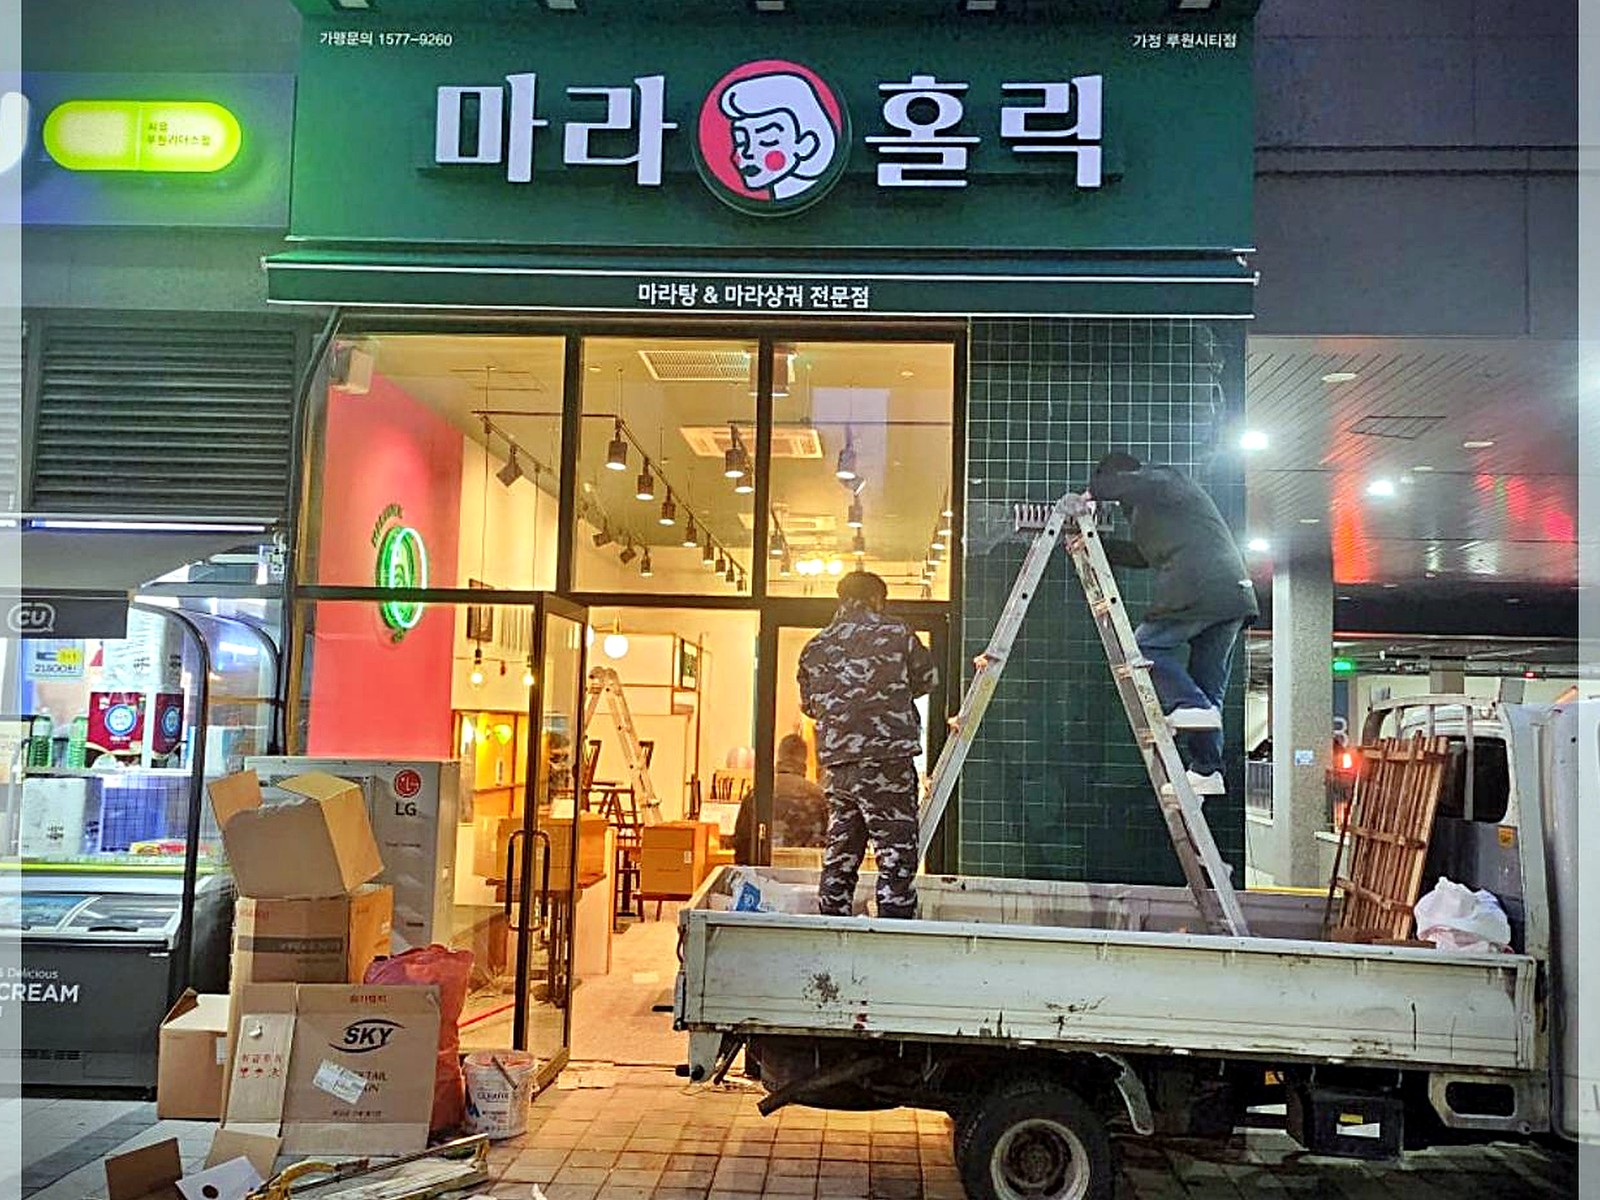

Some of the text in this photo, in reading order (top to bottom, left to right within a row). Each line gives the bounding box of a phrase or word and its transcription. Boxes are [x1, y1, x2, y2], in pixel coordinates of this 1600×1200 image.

[319, 31, 453, 47] 가맹문의 1577-9260
[1132, 33, 1237, 49] 가정 루원시티점
[435, 72, 1103, 188] 마라 홀릭
[637, 282, 870, 310] 마라탕 & 마라샹궈 전문점
[394, 801, 417, 817] LG
[8, 967, 59, 979] Delicious
[0, 983, 80, 1003] CREAM
[343, 1027, 394, 1045] SKY
